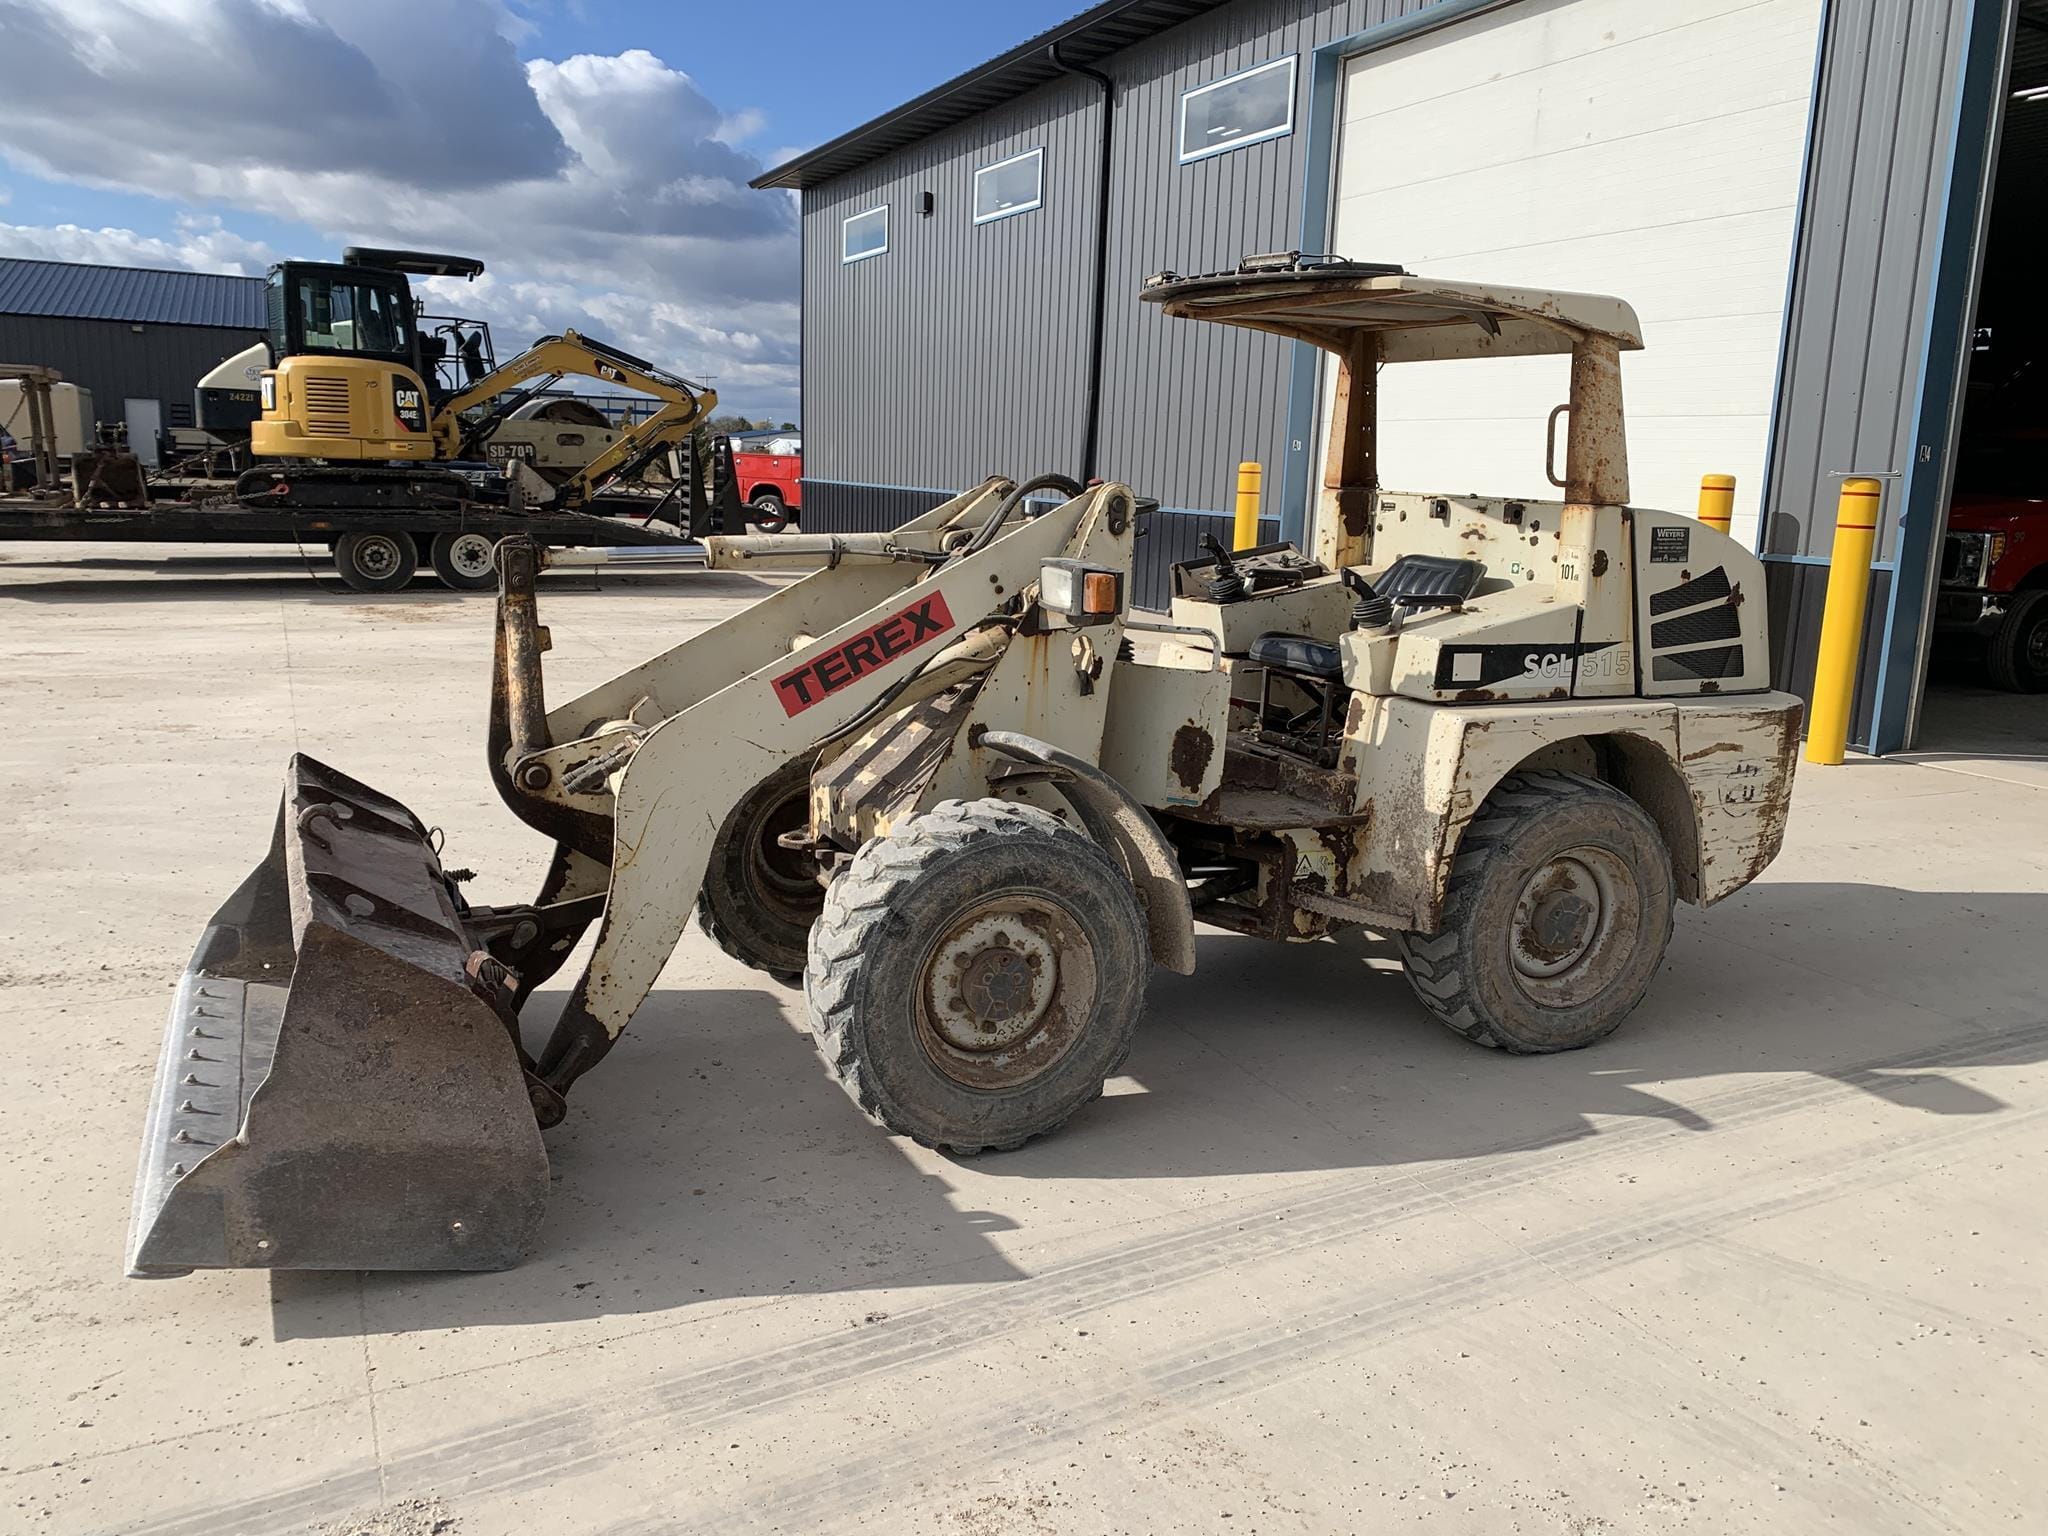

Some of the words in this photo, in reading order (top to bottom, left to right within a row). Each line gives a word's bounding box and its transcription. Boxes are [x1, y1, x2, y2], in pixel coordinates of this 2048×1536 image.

[600, 365, 617, 379] CAT
[396, 390, 419, 408] CAT
[1561, 563, 1574, 580] 101
[780, 600, 944, 705] TEREX
[1523, 653, 1573, 679] SCL
[1582, 651, 1631, 677] 515
